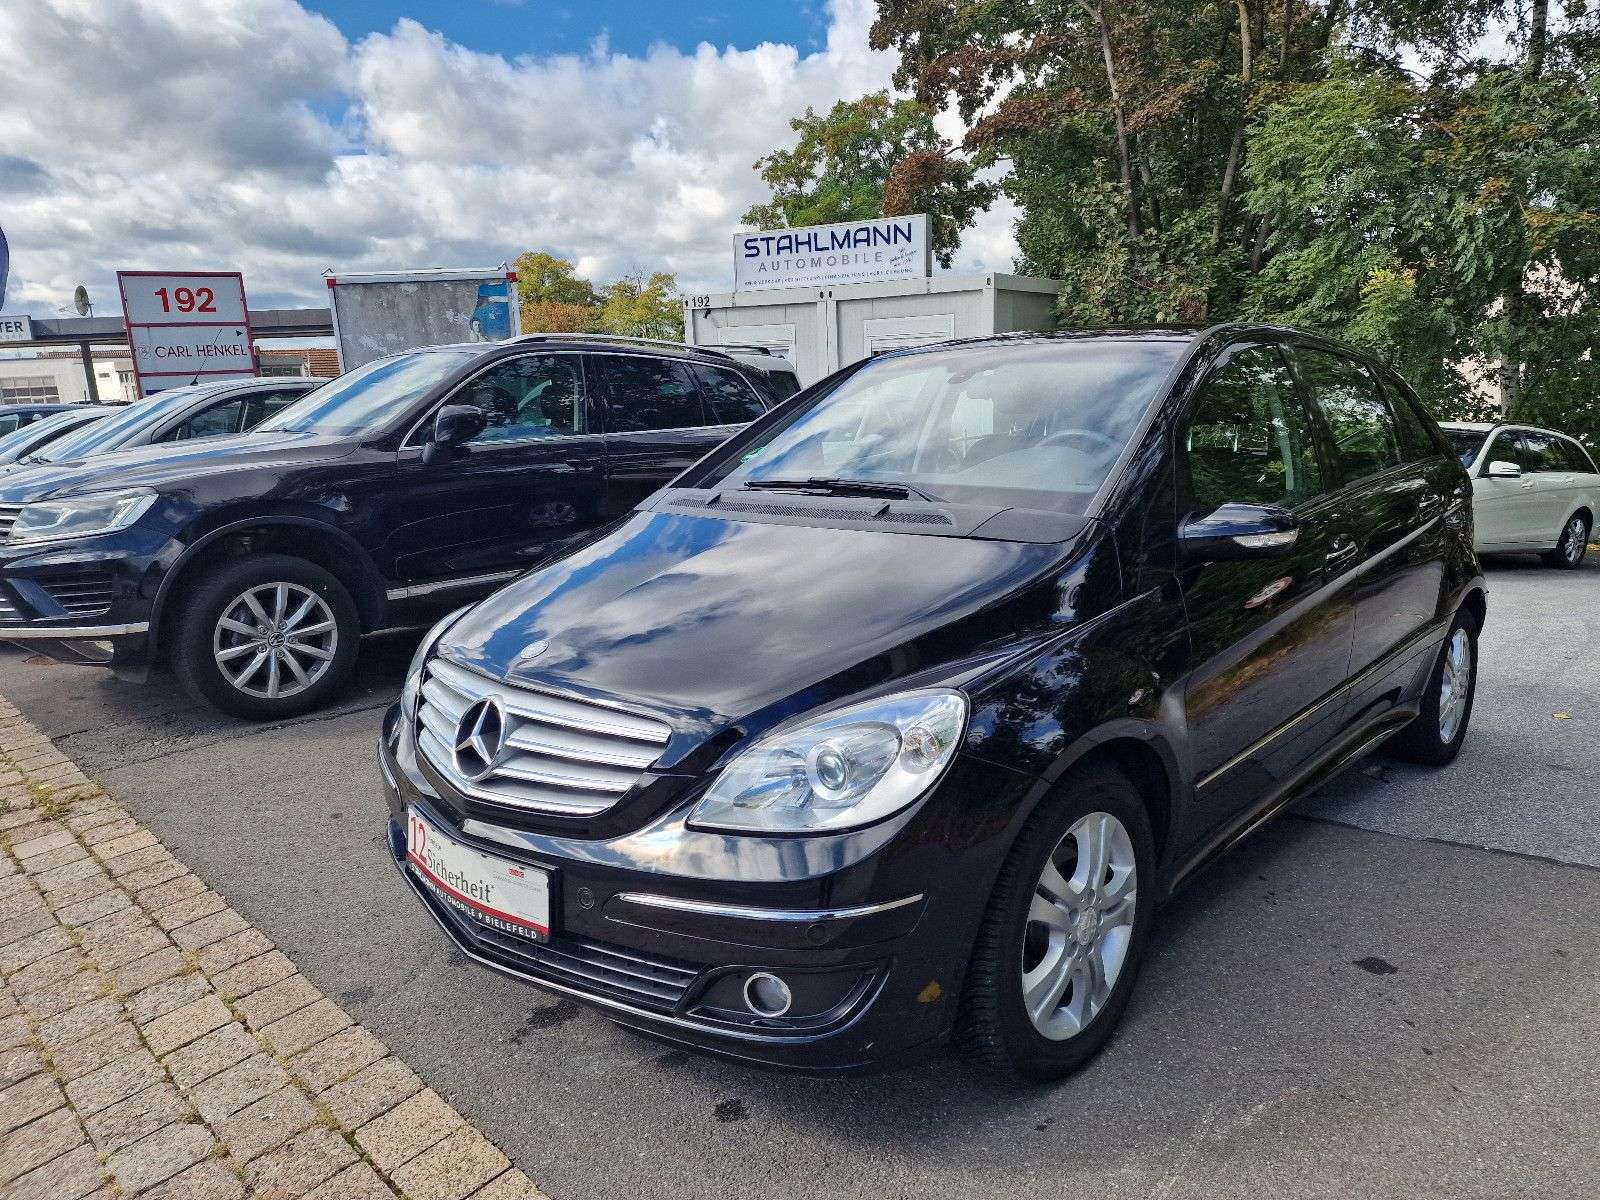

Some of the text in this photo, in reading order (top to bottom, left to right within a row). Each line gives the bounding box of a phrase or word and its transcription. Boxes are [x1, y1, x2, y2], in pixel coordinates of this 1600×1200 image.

[743, 222, 913, 259] STAHLMANN
[757, 252, 884, 273] AUTOMOBILE
[154, 287, 217, 313] 192
[691, 295, 711, 308] 192
[154, 344, 248, 358] CARL HENKEL
[410, 816, 428, 866] 12
[484, 915, 538, 939] BIELEFELD
